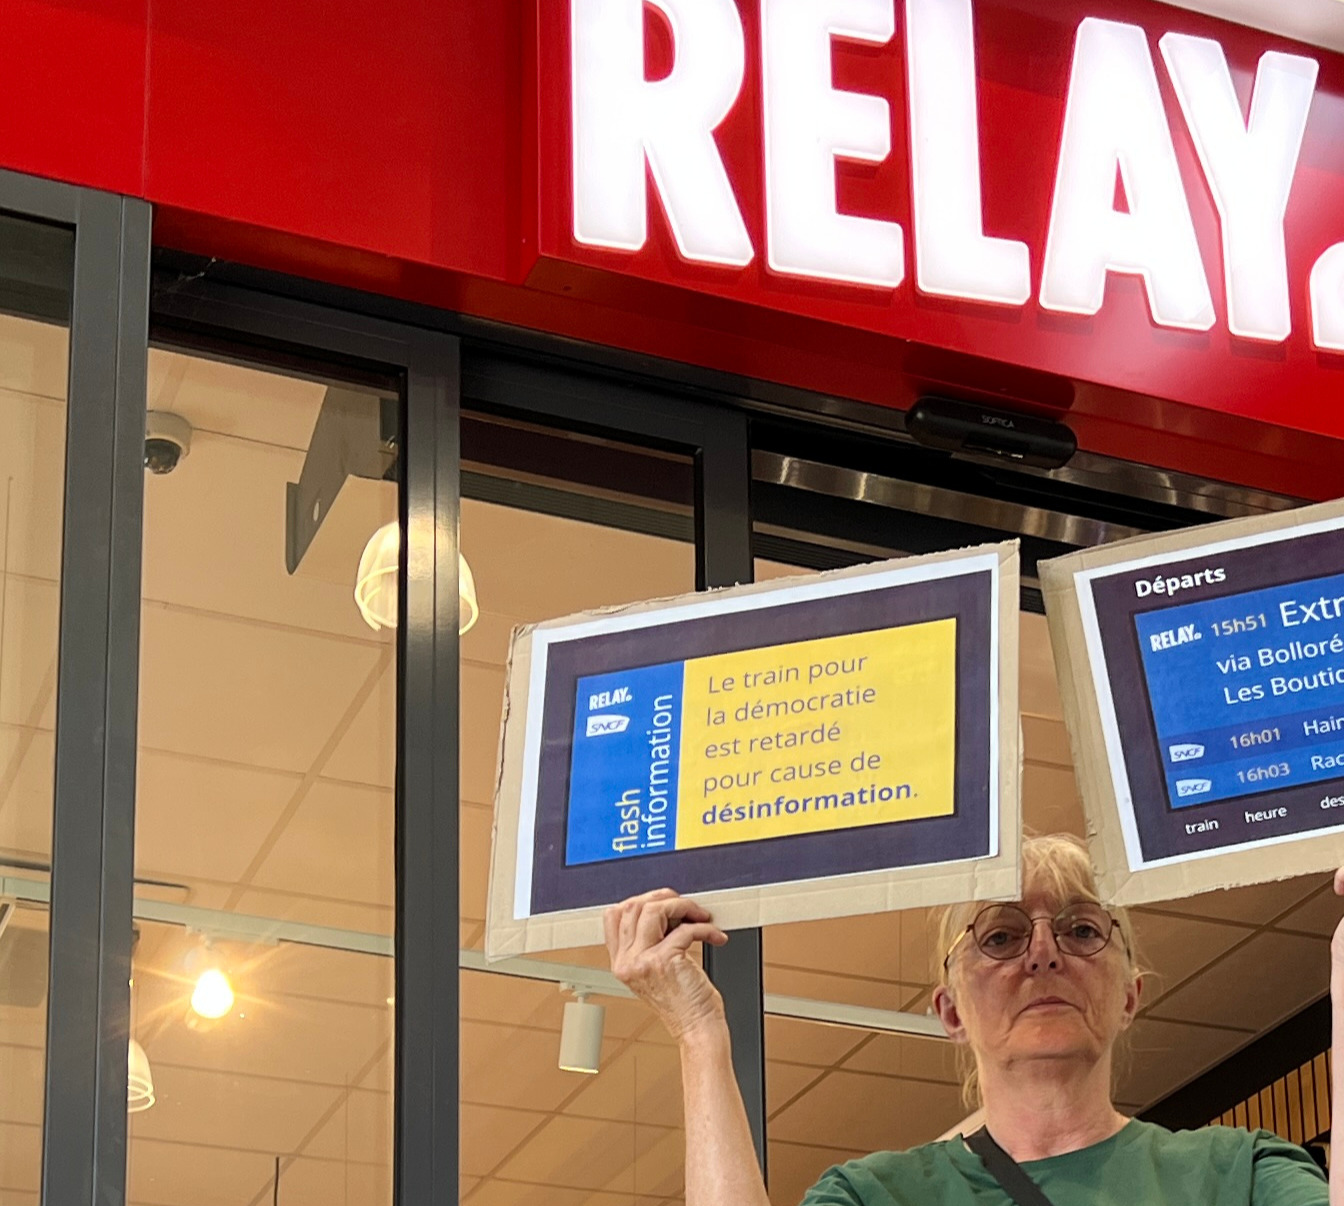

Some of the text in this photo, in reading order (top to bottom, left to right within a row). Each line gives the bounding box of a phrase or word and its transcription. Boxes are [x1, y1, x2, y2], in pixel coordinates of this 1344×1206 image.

[1134, 567, 1227, 598] Départs
[1210, 613, 1267, 637] 15h51
[1216, 654, 1251, 675] via
[1257, 633, 1344, 668] Bolloré
[709, 656, 868, 693] Le train pour
[707, 686, 876, 726] la démocratie
[1223, 684, 1265, 705] Les
[591, 718, 625, 734] SNCF
[705, 721, 841, 759] est retardé
[1173, 747, 1201, 759] SNCF
[1229, 727, 1281, 750] 16h01
[641, 694, 673, 849] information
[704, 751, 881, 798] pour cause de
[1236, 762, 1290, 785] 16h03
[612, 789, 641, 852] flash
[702, 783, 918, 825] désinformation.
[1185, 818, 1219, 835] train
[1245, 805, 1288, 824] heure
